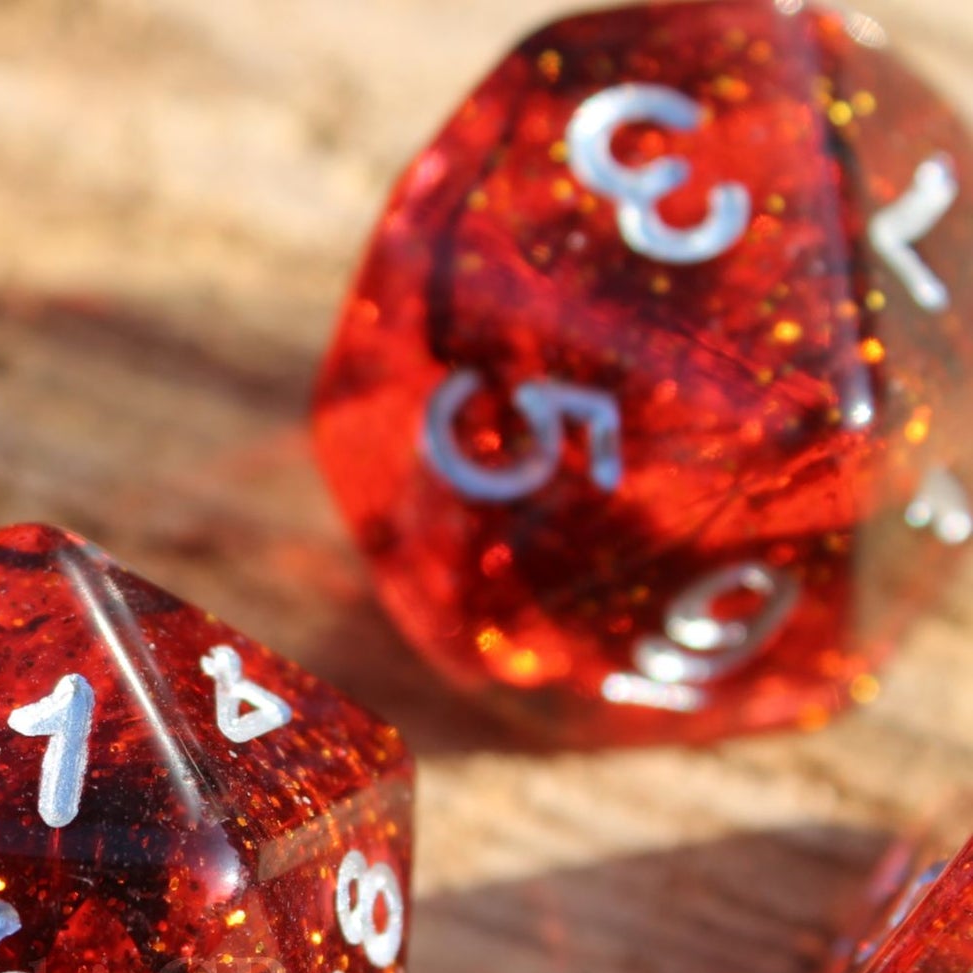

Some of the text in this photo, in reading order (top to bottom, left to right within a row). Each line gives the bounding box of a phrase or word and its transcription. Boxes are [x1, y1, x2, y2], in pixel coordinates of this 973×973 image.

[567, 83, 752, 264] 3
[422, 368, 623, 503] 5
[199, 644, 293, 744] 4
